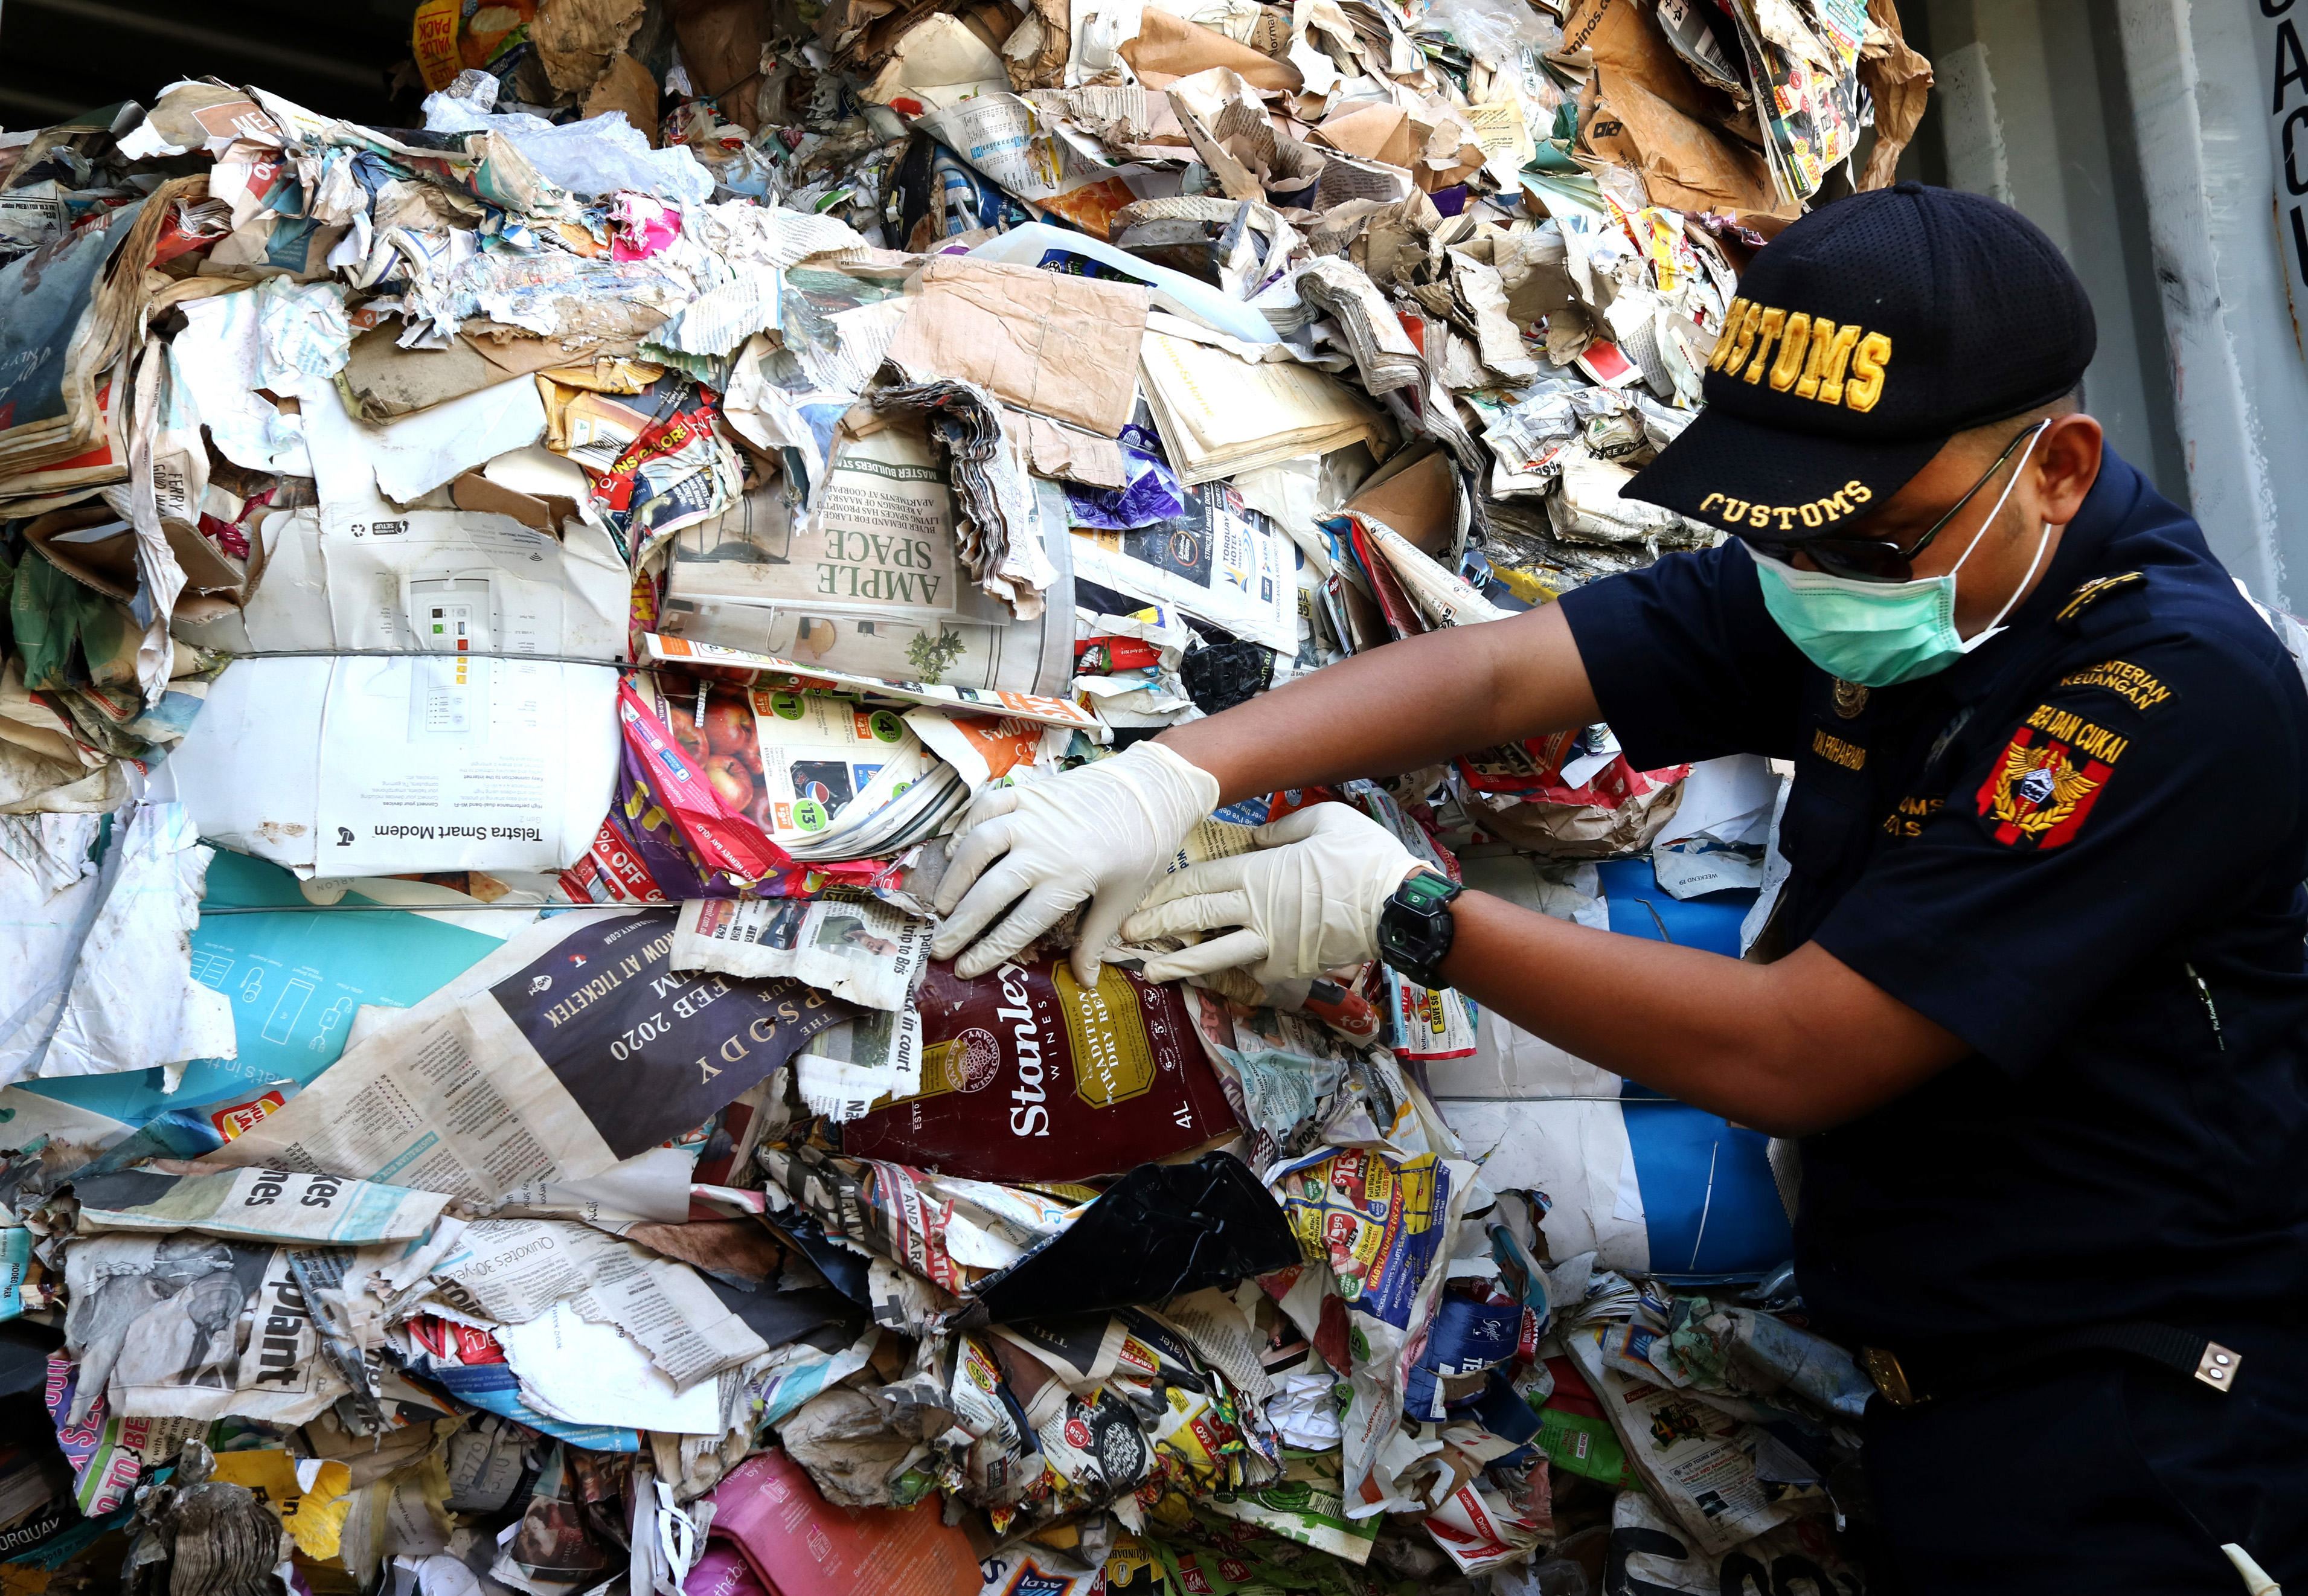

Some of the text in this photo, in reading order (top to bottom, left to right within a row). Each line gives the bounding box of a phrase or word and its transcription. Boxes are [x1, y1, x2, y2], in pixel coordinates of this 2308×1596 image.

[419, 18, 452, 40] PACK
[420, 37, 452, 59] VALUE
[854, 460, 937, 481] MASTER BUILDERS
[168, 472, 184, 511] FERRY
[864, 499, 876, 508] OF
[868, 490, 934, 507] APARTMENTS AT
[1699, 480, 1873, 530] CUSTOMS
[861, 507, 939, 525] LIVING SPACES HAS
[876, 499, 916, 515] REDESIGN
[853, 514, 935, 534] BUYER DEMAND FOR
[824, 528, 932, 570] SPACE
[816, 562, 941, 605] AMPLE
[2059, 670, 2154, 710] KEUANGAN
[2026, 704, 2129, 764] BEA DAN CUKAI
[374, 824, 543, 843] Telstra Smart Modem
[696, 822, 714, 840] (QLD)
[611, 850, 647, 886] OFF
[711, 839, 745, 870] HERVEY BAY
[893, 924, 920, 976] trip to Bris
[543, 953, 642, 1029] AT TICKETEK
[609, 973, 732, 1062] FEB 2020
[799, 1013, 833, 1036] THE
[1430, 995, 1442, 1025] SAVE $6
[896, 1017, 917, 1072] in court
[1037, 1000, 1060, 1081] WINES
[1071, 1005, 1088, 1060] AUSTRALIAN
[945, 1029, 1000, 1092] STANLEY WINE COMPANY
[996, 961, 1050, 1136] Stanley
[1101, 1029, 1120, 1068] DRY
[1172, 1100, 1193, 1129] 4L
[400, 1134, 435, 1164] AUSTRALIAN
[1359, 1158, 1367, 1167] kg
[1370, 1153, 1379, 1172] Angus
[1376, 1167, 1384, 1186] Rumps
[902, 1192, 920, 1222] AND
[494, 1237, 555, 1268] Quixote's
[1368, 1225, 1397, 1288] WAGYU RUMPS
[10, 1263, 21, 1284] RODEO
[1158, 1334, 1184, 1359] later
[1461, 1492, 1492, 1539] coles Drinks
[1021, 1574, 1062, 1589] ALDI
